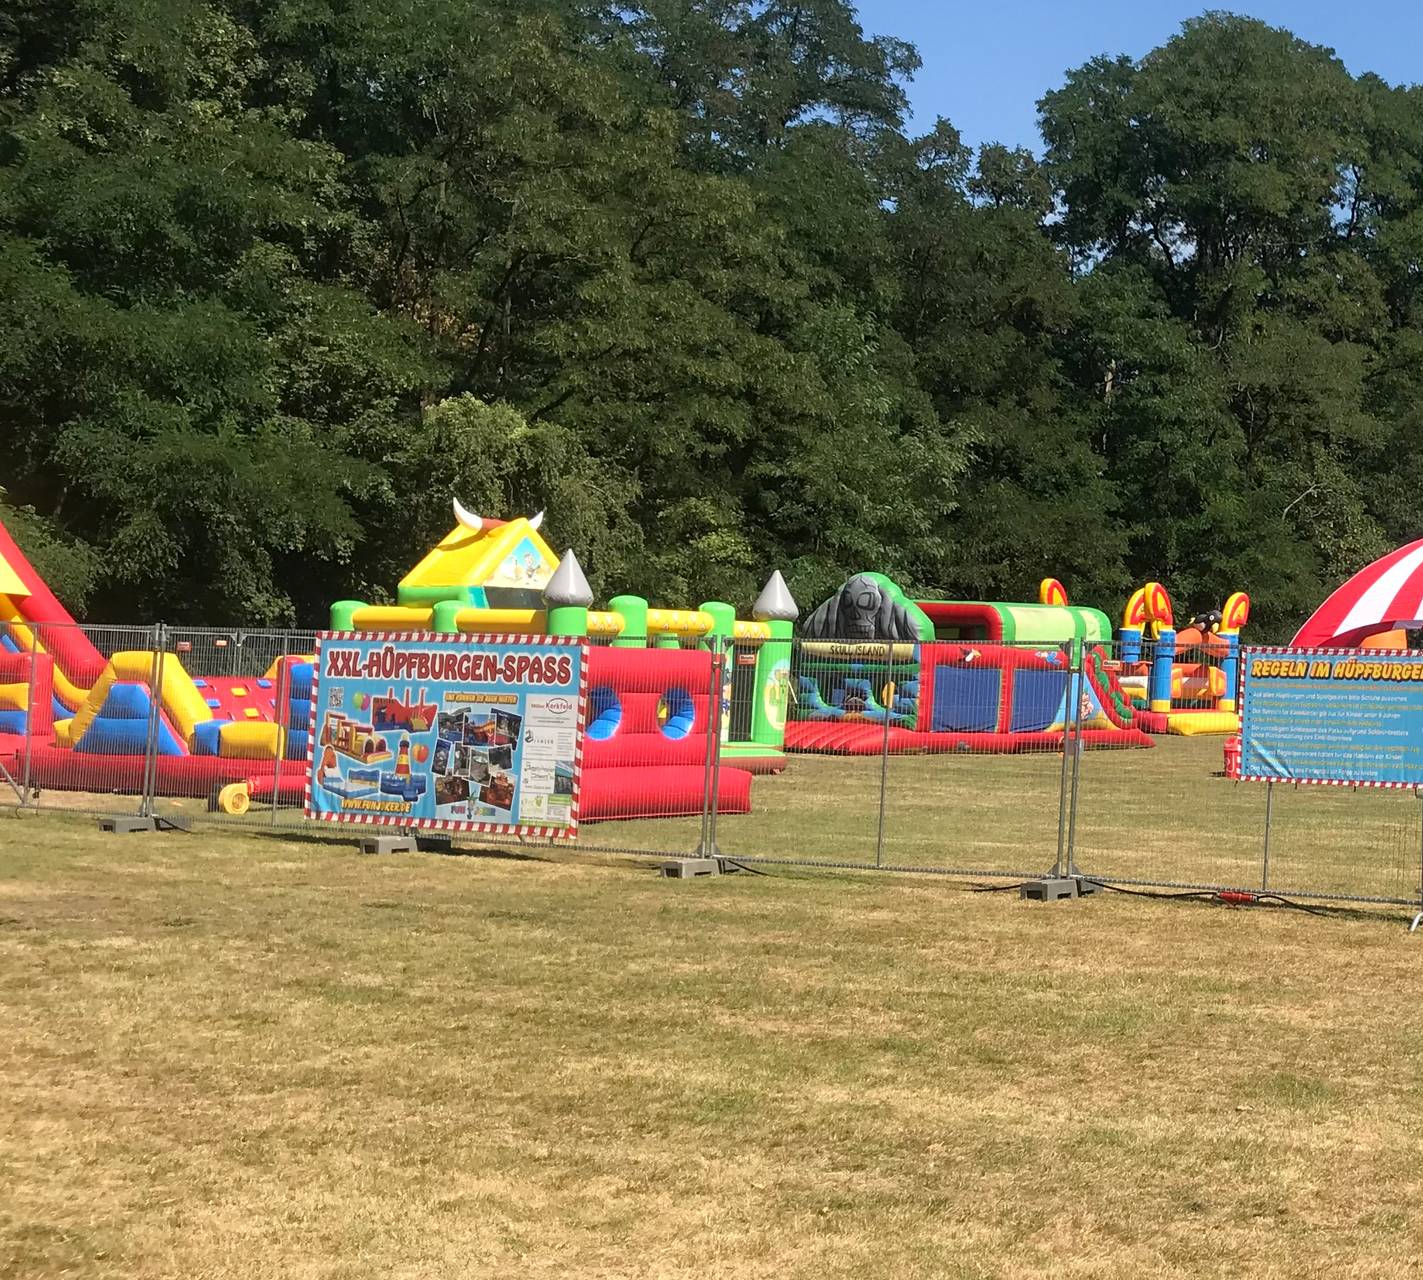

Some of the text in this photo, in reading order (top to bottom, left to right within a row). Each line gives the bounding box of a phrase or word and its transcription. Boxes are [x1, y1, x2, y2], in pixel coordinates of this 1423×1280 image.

[830, 645, 886, 657] SKULL ISLAND
[327, 646, 572, 684] XXL-HÜPFBURGEN-SPASS
[1251, 660, 1307, 679] REGELN
[1310, 662, 1330, 679] IM
